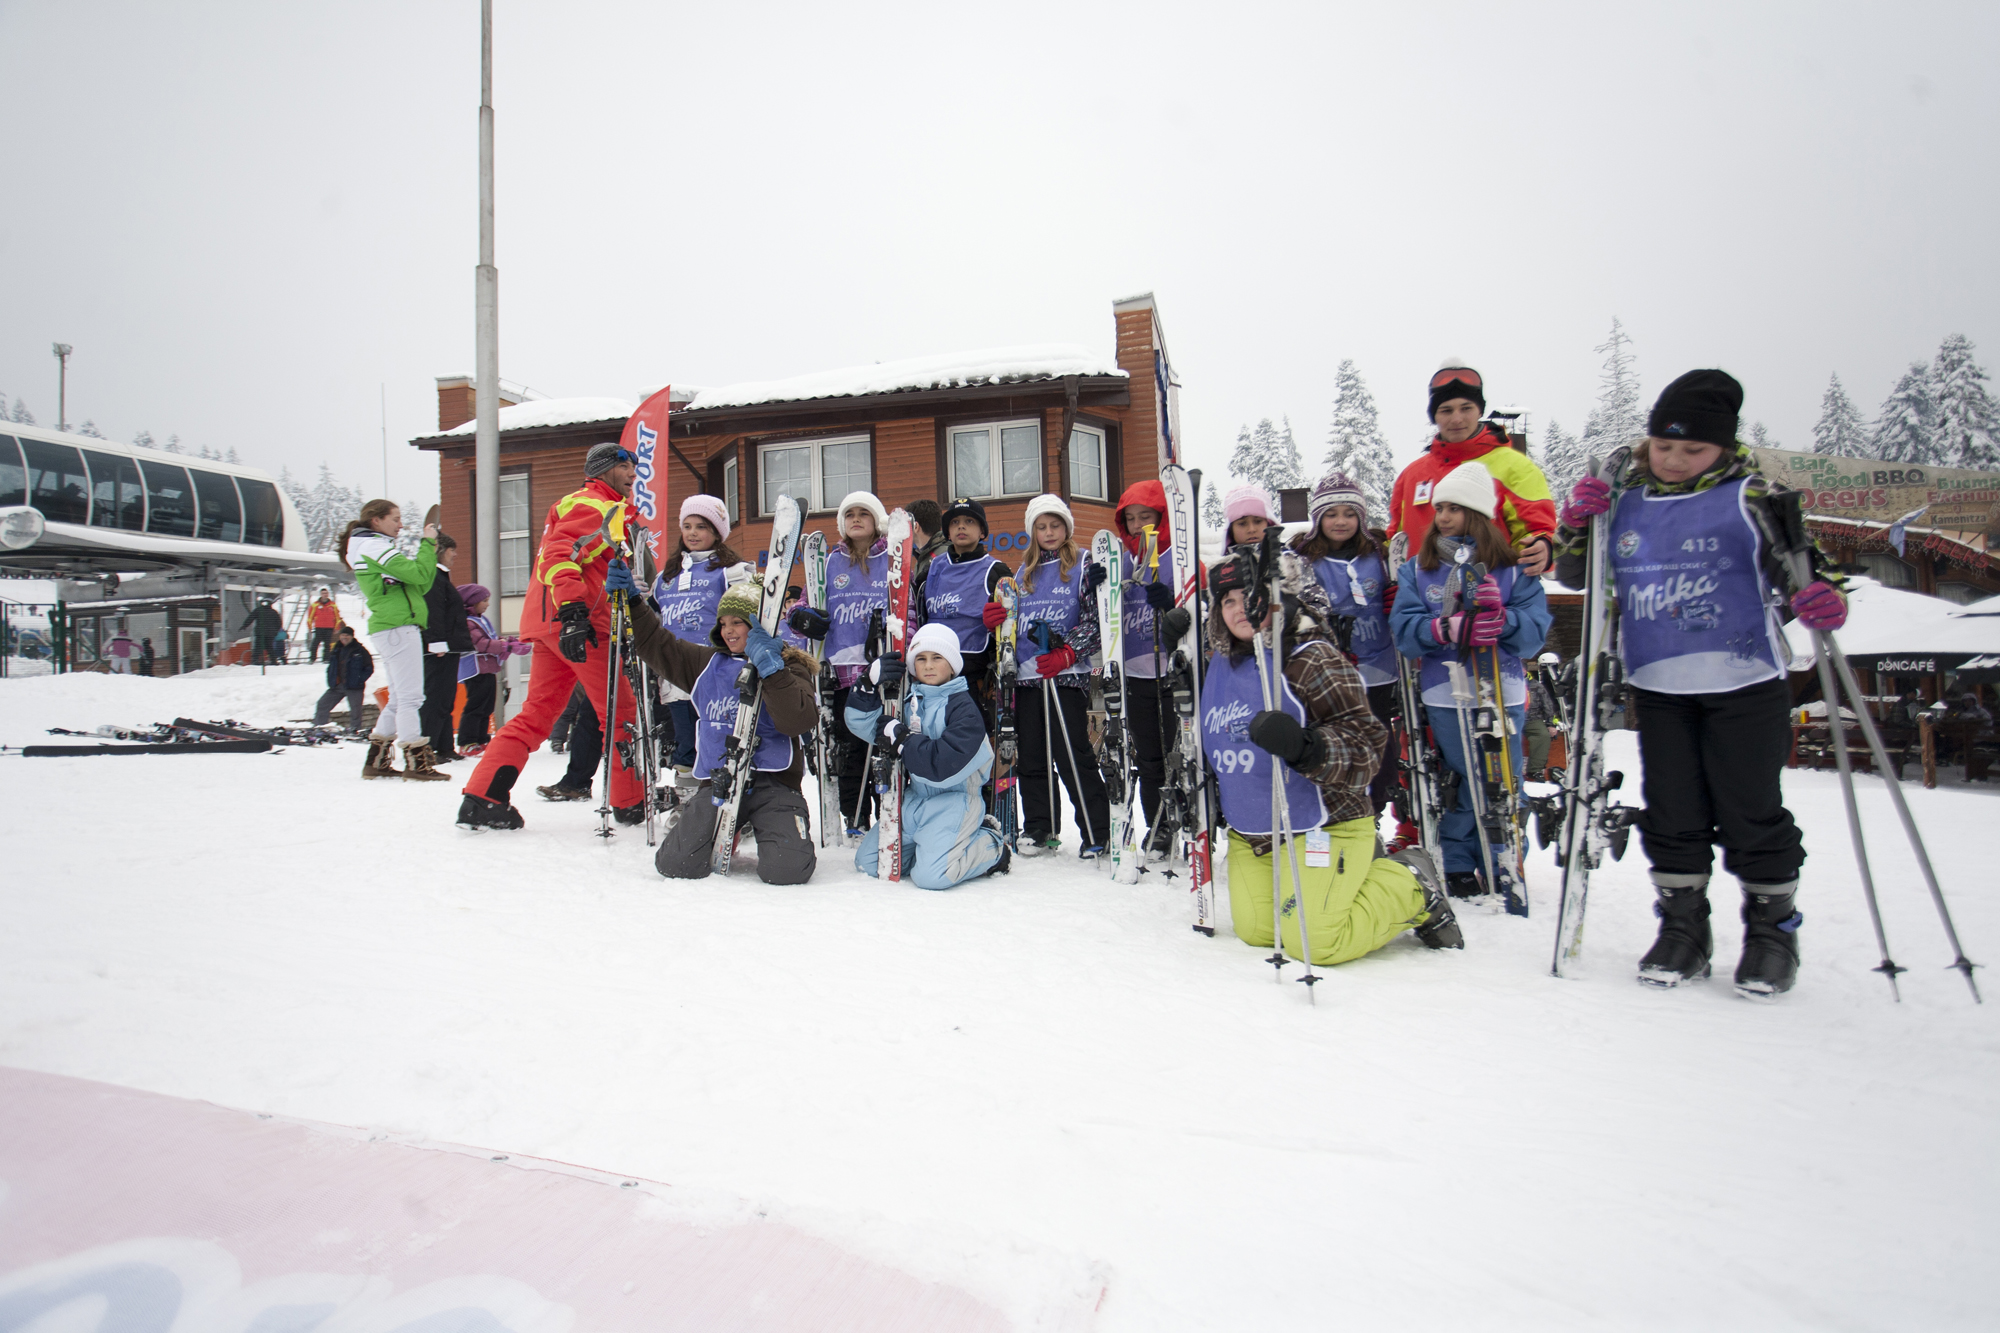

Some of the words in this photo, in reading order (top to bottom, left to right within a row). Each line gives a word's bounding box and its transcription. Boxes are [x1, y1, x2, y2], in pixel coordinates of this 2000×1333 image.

[634, 421, 658, 520] SPORT
[1788, 456, 1829, 472] Bar
[1824, 463, 1838, 476] &
[1811, 471, 1868, 489] Food
[1872, 468, 1926, 486] BBQ
[1797, 487, 1888, 510] Deers
[1930, 514, 1987, 525] Kamenitza
[1680, 537, 1720, 552] 413
[892, 540, 904, 589] ORIO
[1645, 563, 1679, 572] КАРАШ
[1680, 562, 1700, 570] СКИ
[691, 578, 710, 588] 390
[1051, 586, 1071, 595] 446
[925, 592, 962, 614] Milka
[1627, 572, 1721, 621] Milka
[660, 597, 705, 627] Milka
[833, 597, 888, 625] Milka
[1018, 605, 1069, 635] Milka
[1204, 699, 1253, 735] Milka
[1212, 748, 1256, 774] 299
